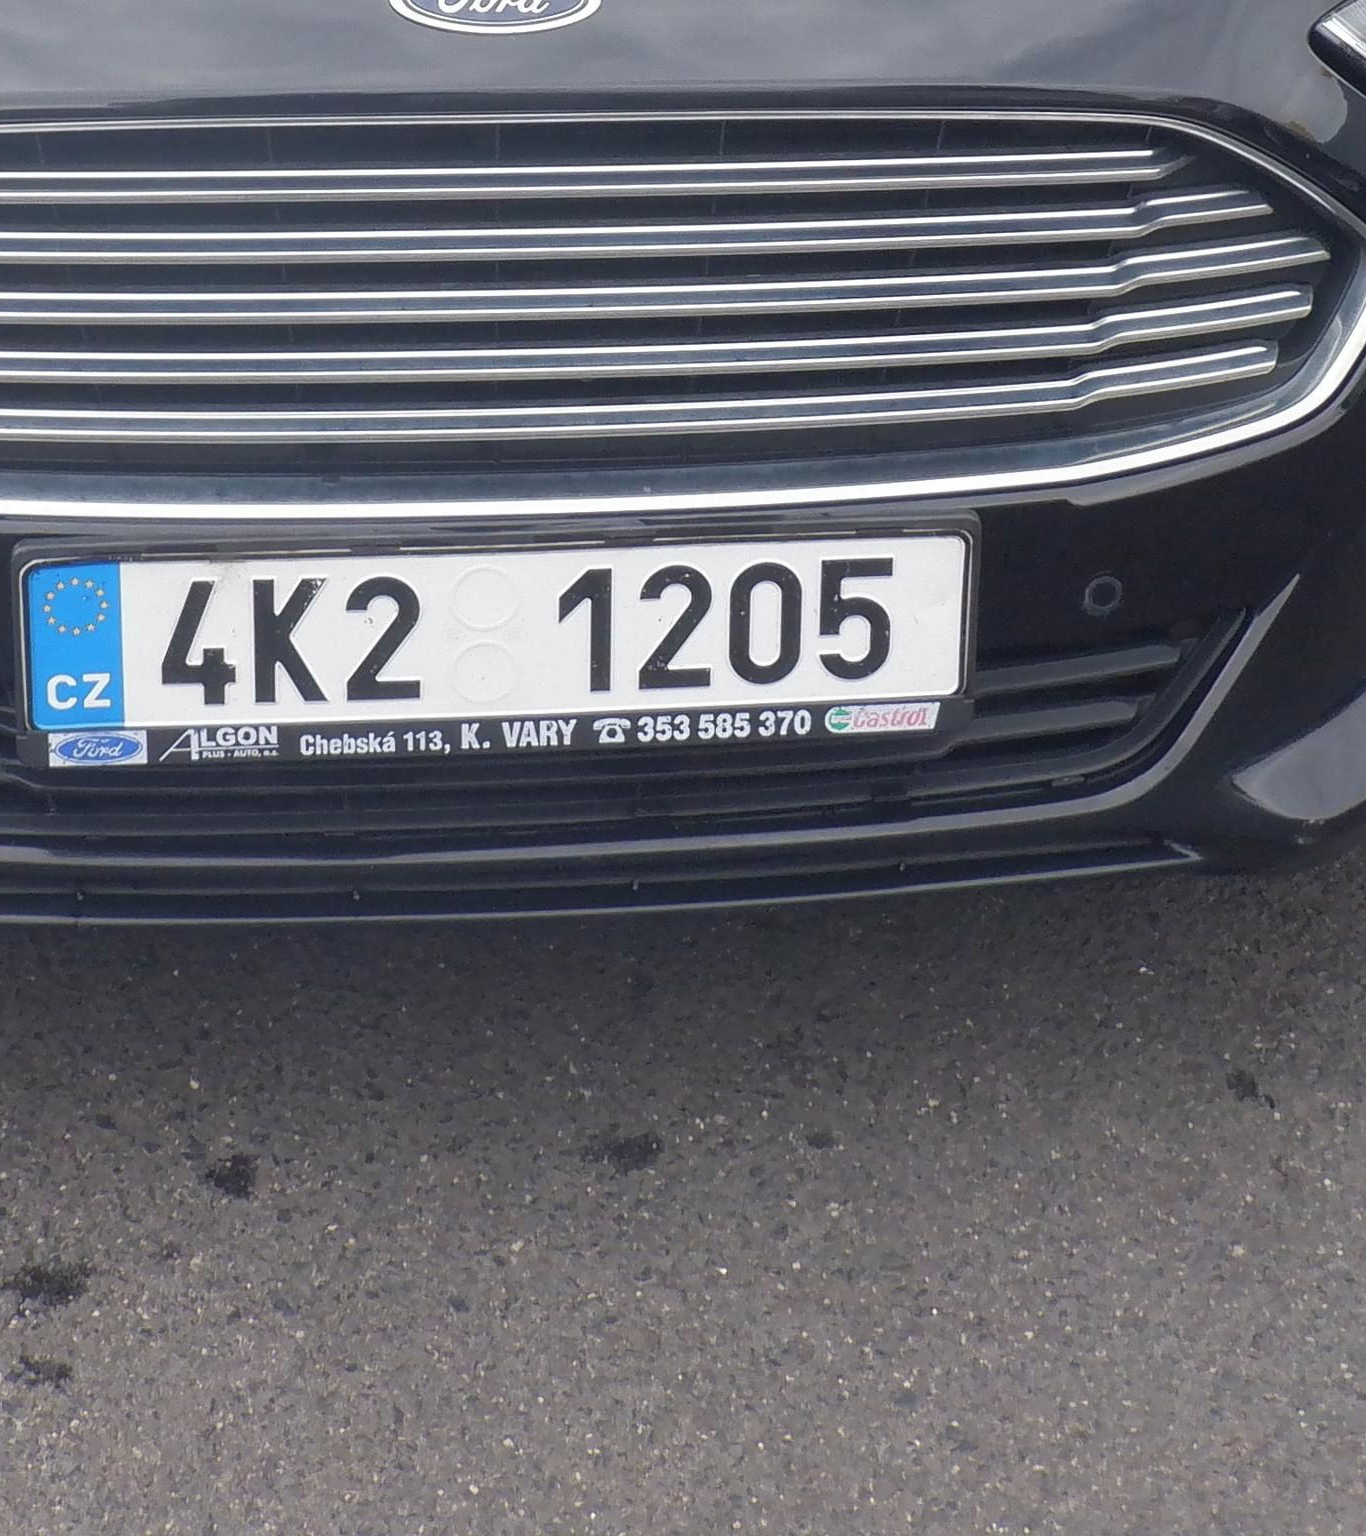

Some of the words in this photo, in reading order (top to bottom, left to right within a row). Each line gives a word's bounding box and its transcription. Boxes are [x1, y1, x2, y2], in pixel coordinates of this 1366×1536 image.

[161, 575, 422, 705] 4K2
[558, 557, 895, 693] 1205
[46, 672, 112, 711] CZ
[299, 731, 396, 756] Chebská
[403, 729, 452, 755] 113,
[461, 722, 491, 750] K.
[501, 718, 578, 748] VARY
[636, 715, 691, 743] 353
[697, 712, 752, 740] 585
[758, 709, 812, 736] 370
[853, 707, 930, 728] Castrol
[72, 736, 125, 758] Ford
[158, 725, 279, 761] ALGON
